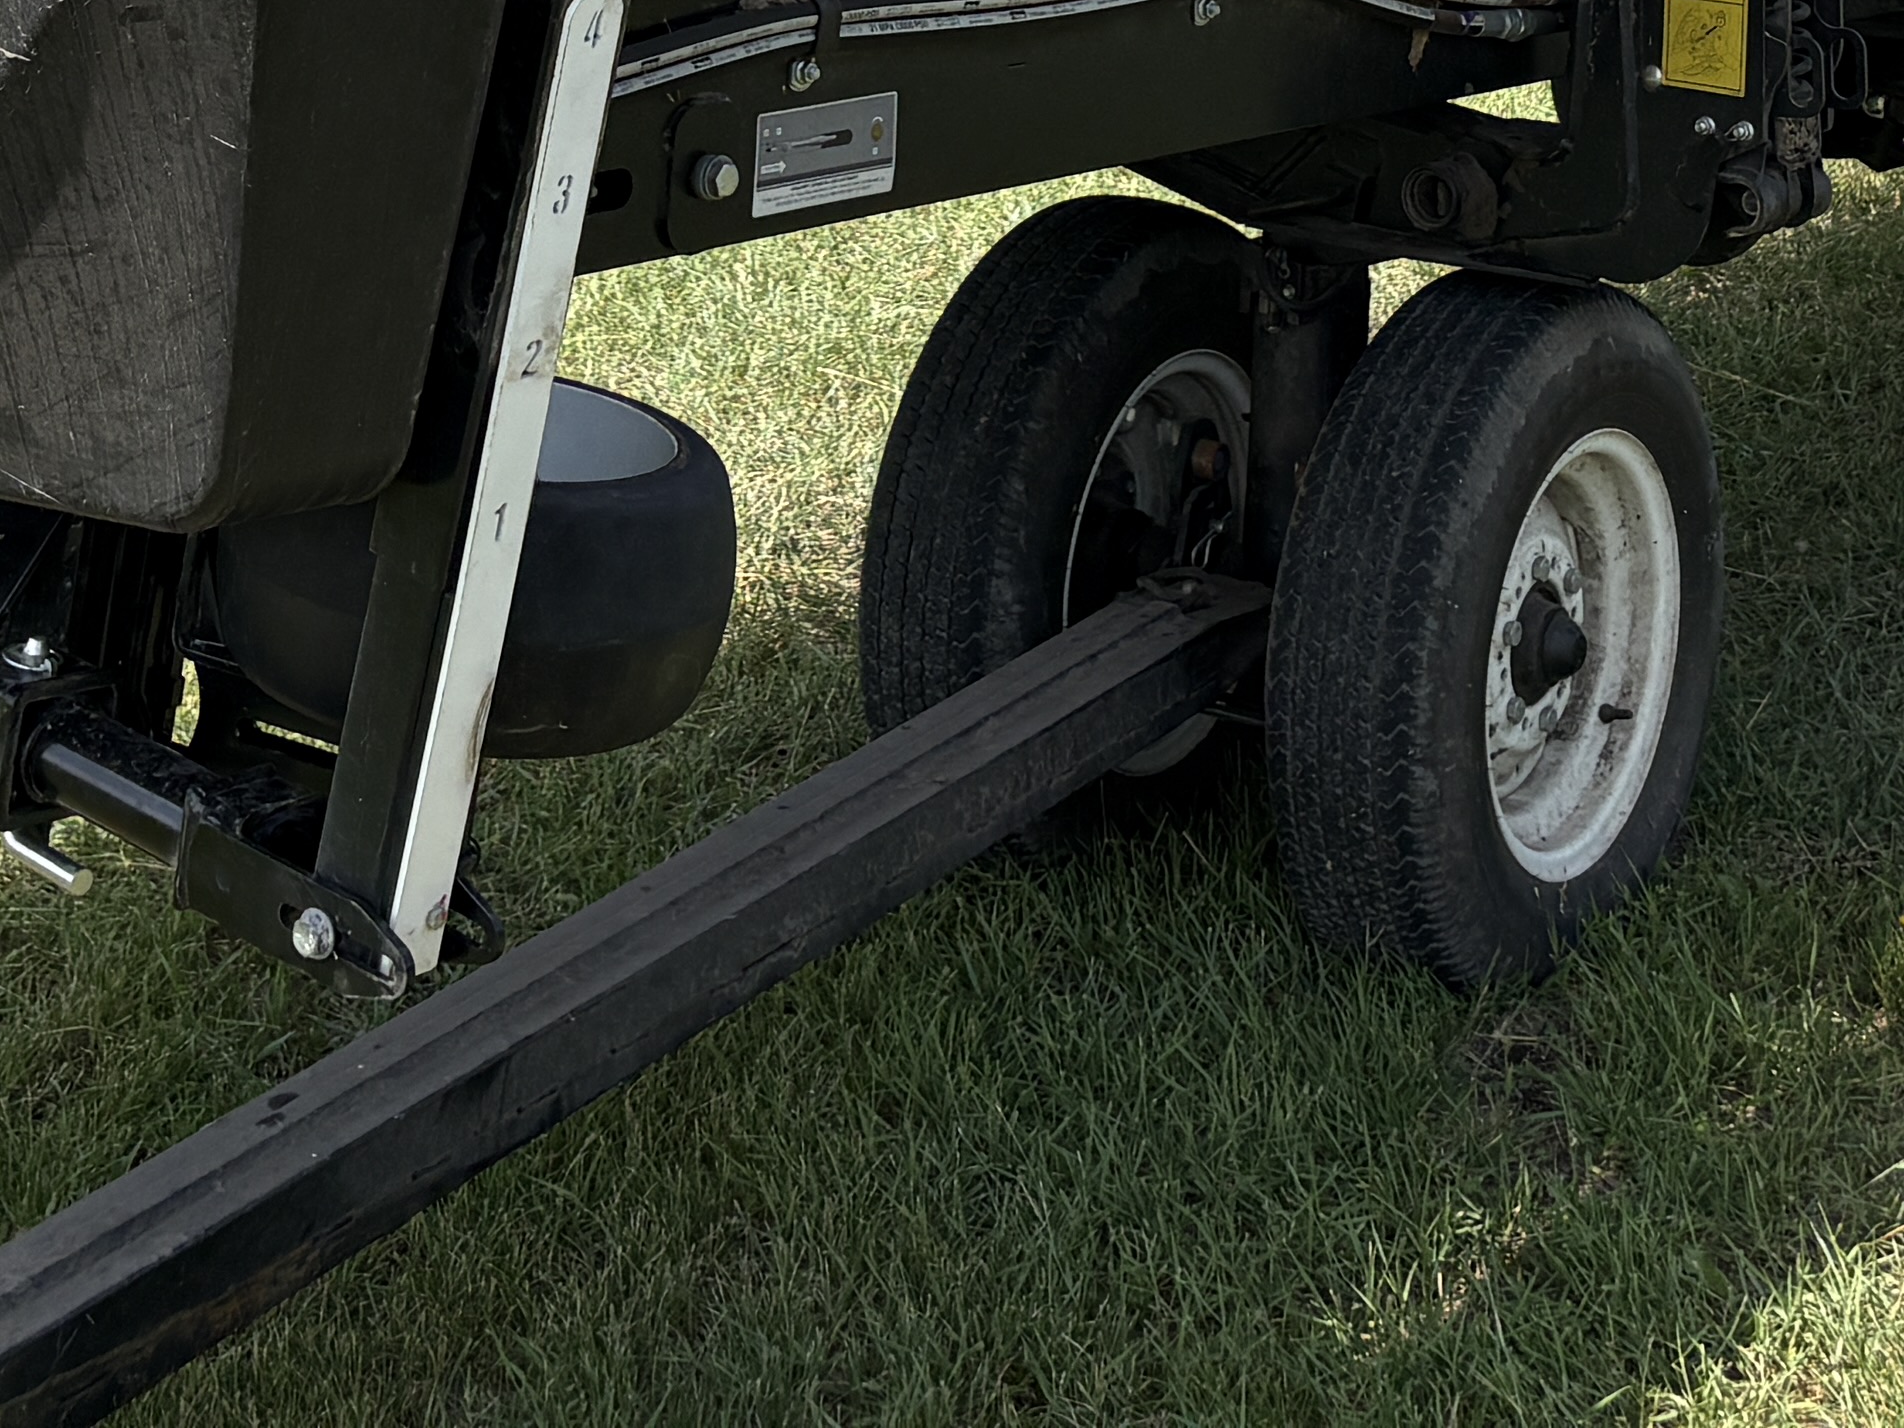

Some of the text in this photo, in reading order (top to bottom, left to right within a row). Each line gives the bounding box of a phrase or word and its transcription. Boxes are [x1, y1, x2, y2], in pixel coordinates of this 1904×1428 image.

[583, 8, 604, 49] 4
[552, 174, 574, 215] 3
[521, 339, 544, 380] 2
[494, 502, 508, 543] 1
